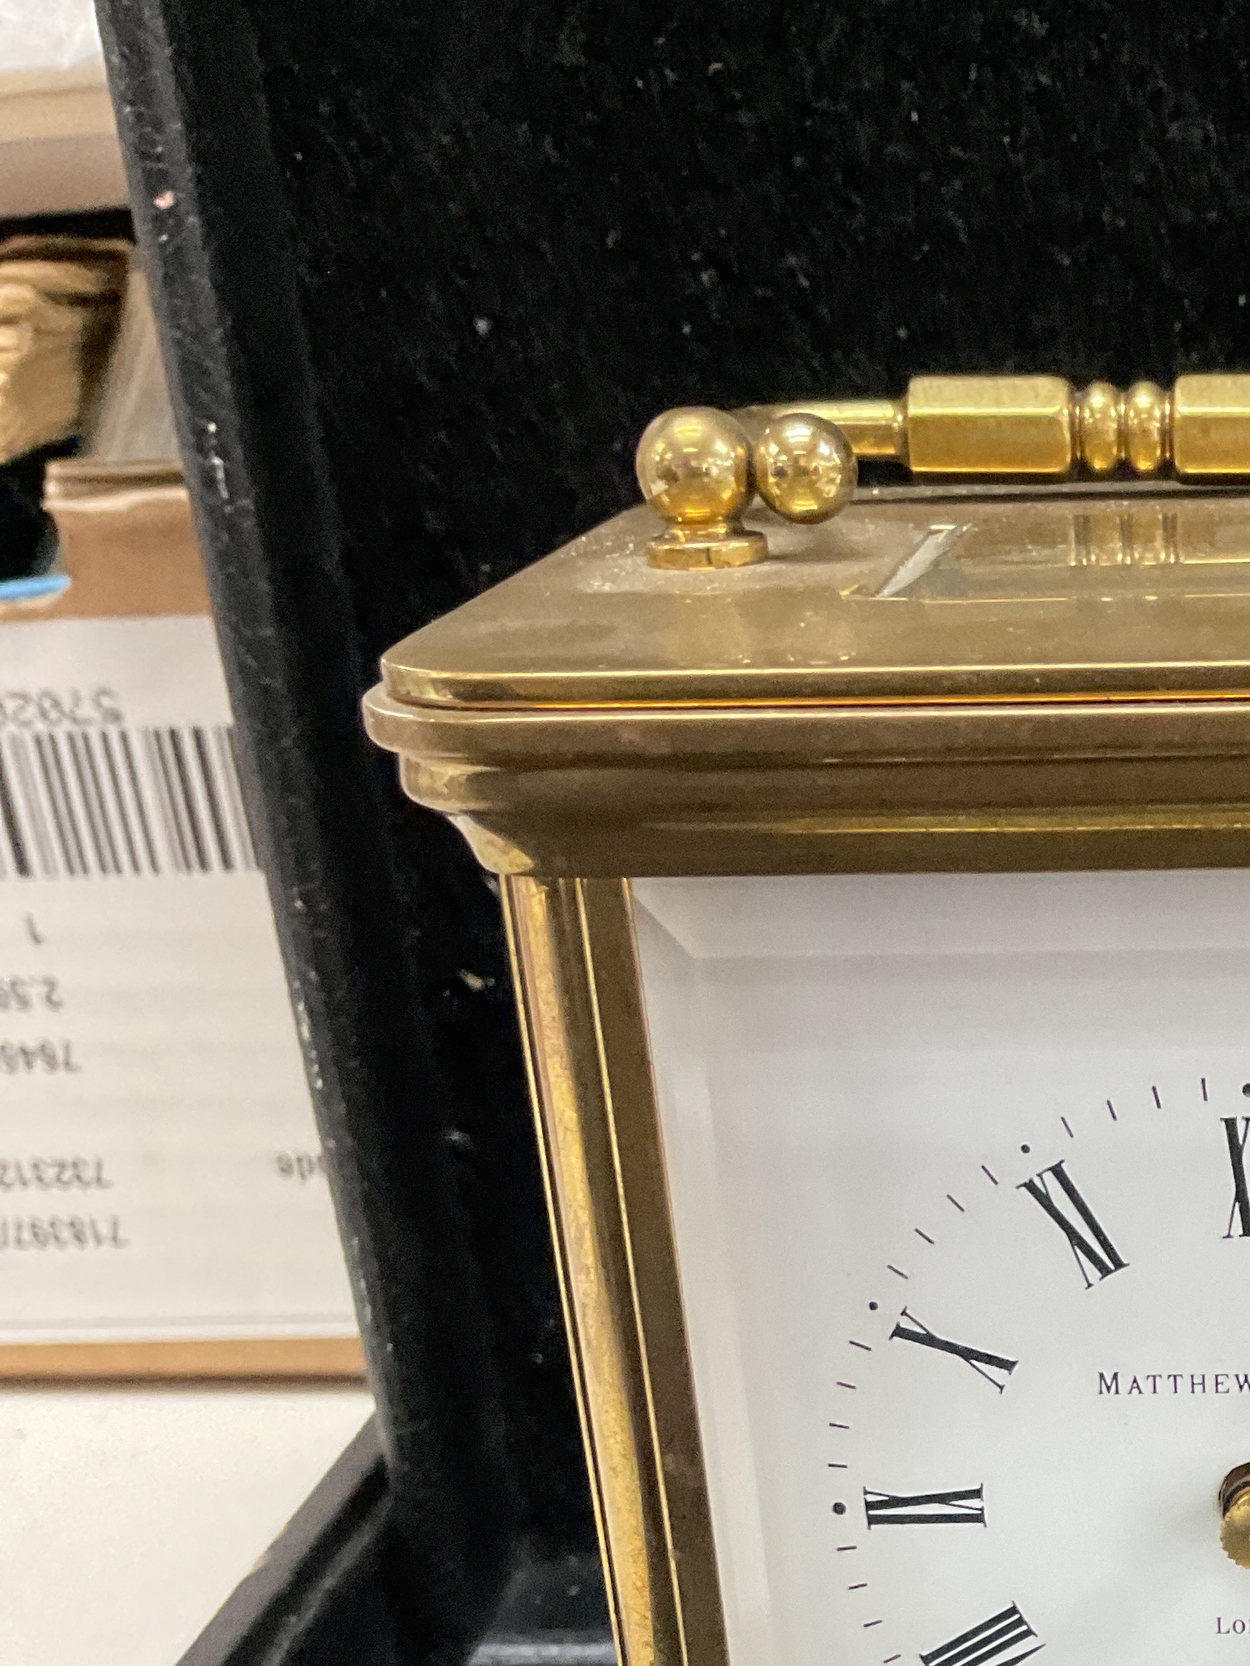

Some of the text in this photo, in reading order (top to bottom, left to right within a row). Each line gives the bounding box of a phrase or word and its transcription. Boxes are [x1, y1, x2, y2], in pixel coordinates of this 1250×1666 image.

[1017, 1160, 1129, 1289] XI
[889, 1307, 1018, 1393] X
[864, 1484, 985, 1529] IX
